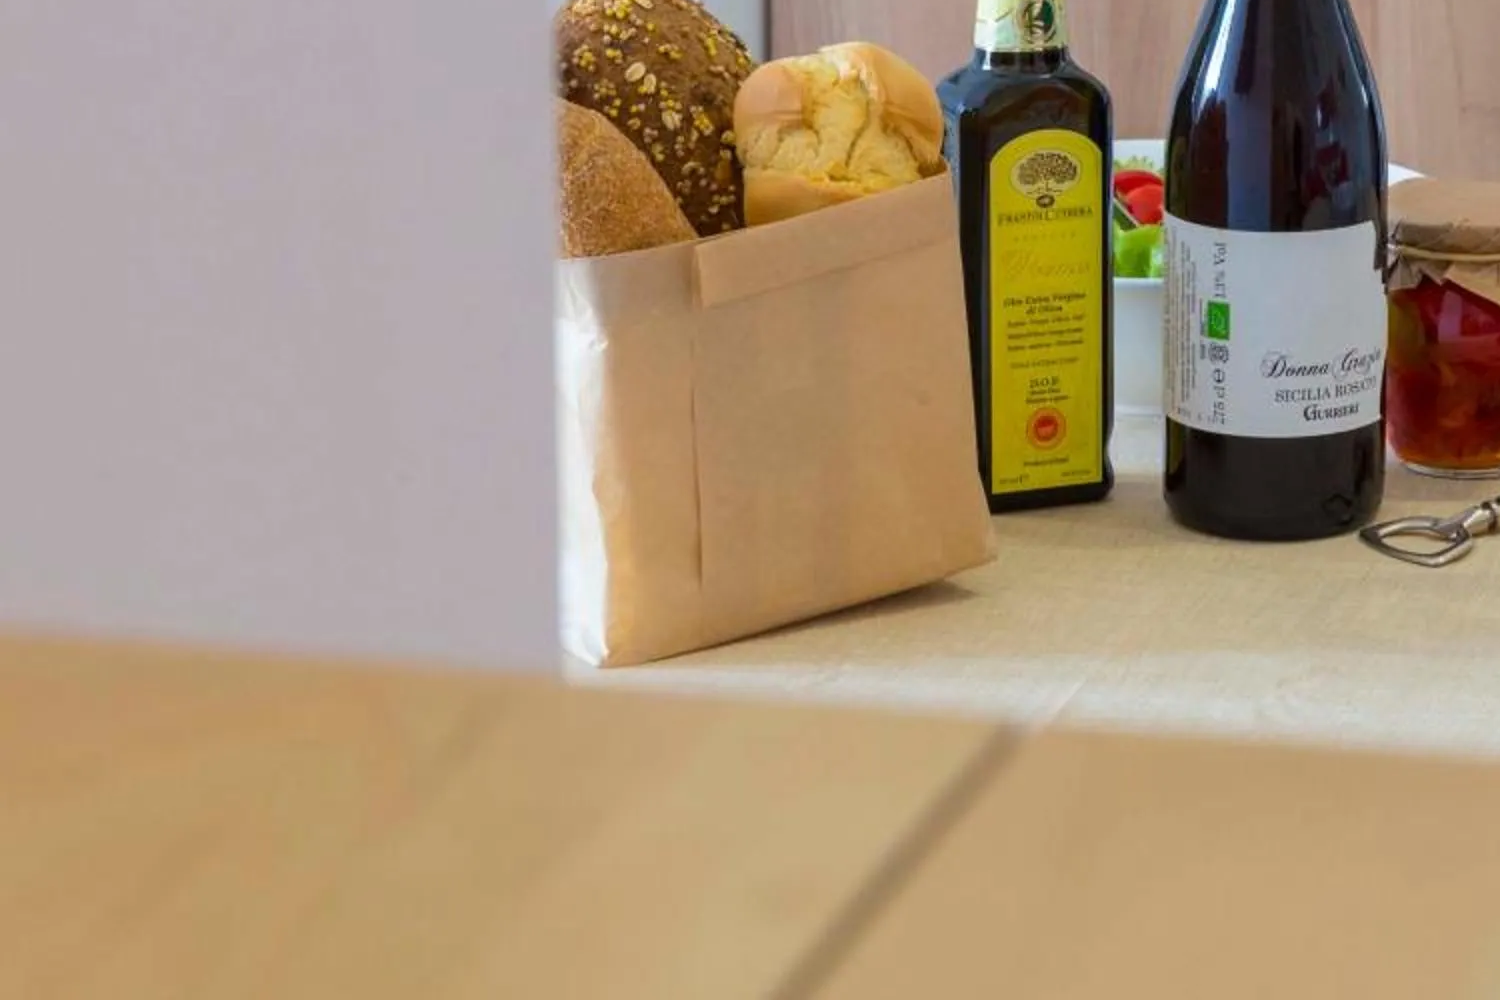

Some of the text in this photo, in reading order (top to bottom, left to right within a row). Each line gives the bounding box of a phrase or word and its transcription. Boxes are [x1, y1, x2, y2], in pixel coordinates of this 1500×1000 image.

[1213, 241, 1227, 266] Vol
[1258, 350, 1330, 379] Donna
[1274, 385, 1331, 404] SICILIA
